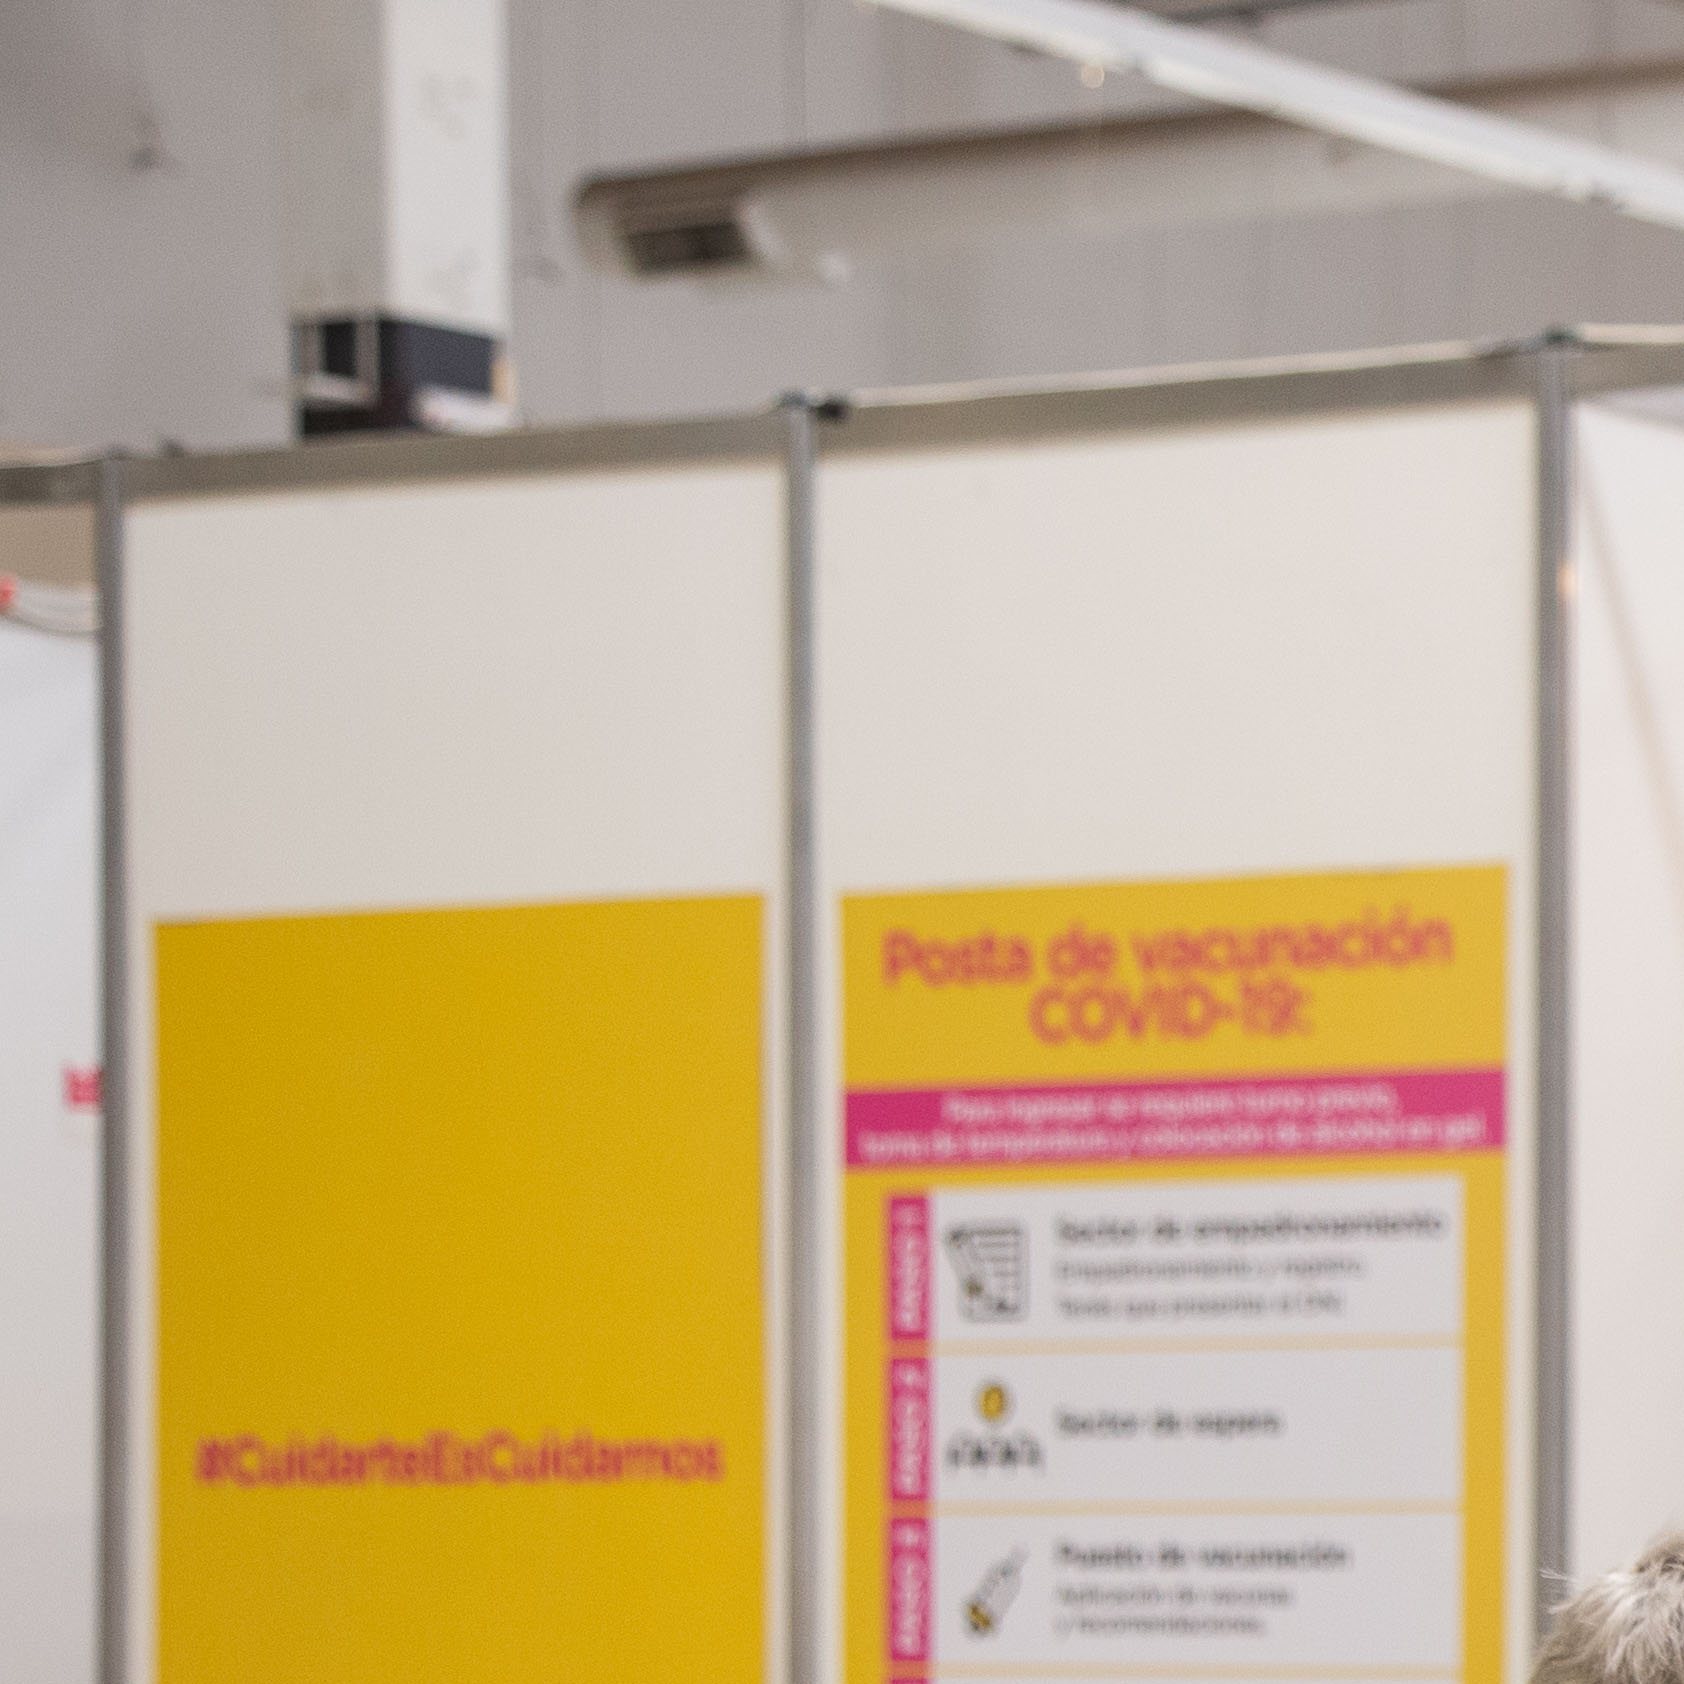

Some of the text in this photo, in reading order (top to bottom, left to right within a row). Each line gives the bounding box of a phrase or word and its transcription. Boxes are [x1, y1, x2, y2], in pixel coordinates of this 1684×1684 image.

[881, 903, 1458, 988] Posta de vacunación
[1054, 1215, 1144, 1245] Sector
[1147, 1213, 1185, 1242] de
[1054, 1406, 1144, 1438] Sector
[1147, 1407, 1185, 1437] de
[194, 1427, 726, 1487] #CuidarteEsCuidarnos
[1152, 1538, 1189, 1569] de
